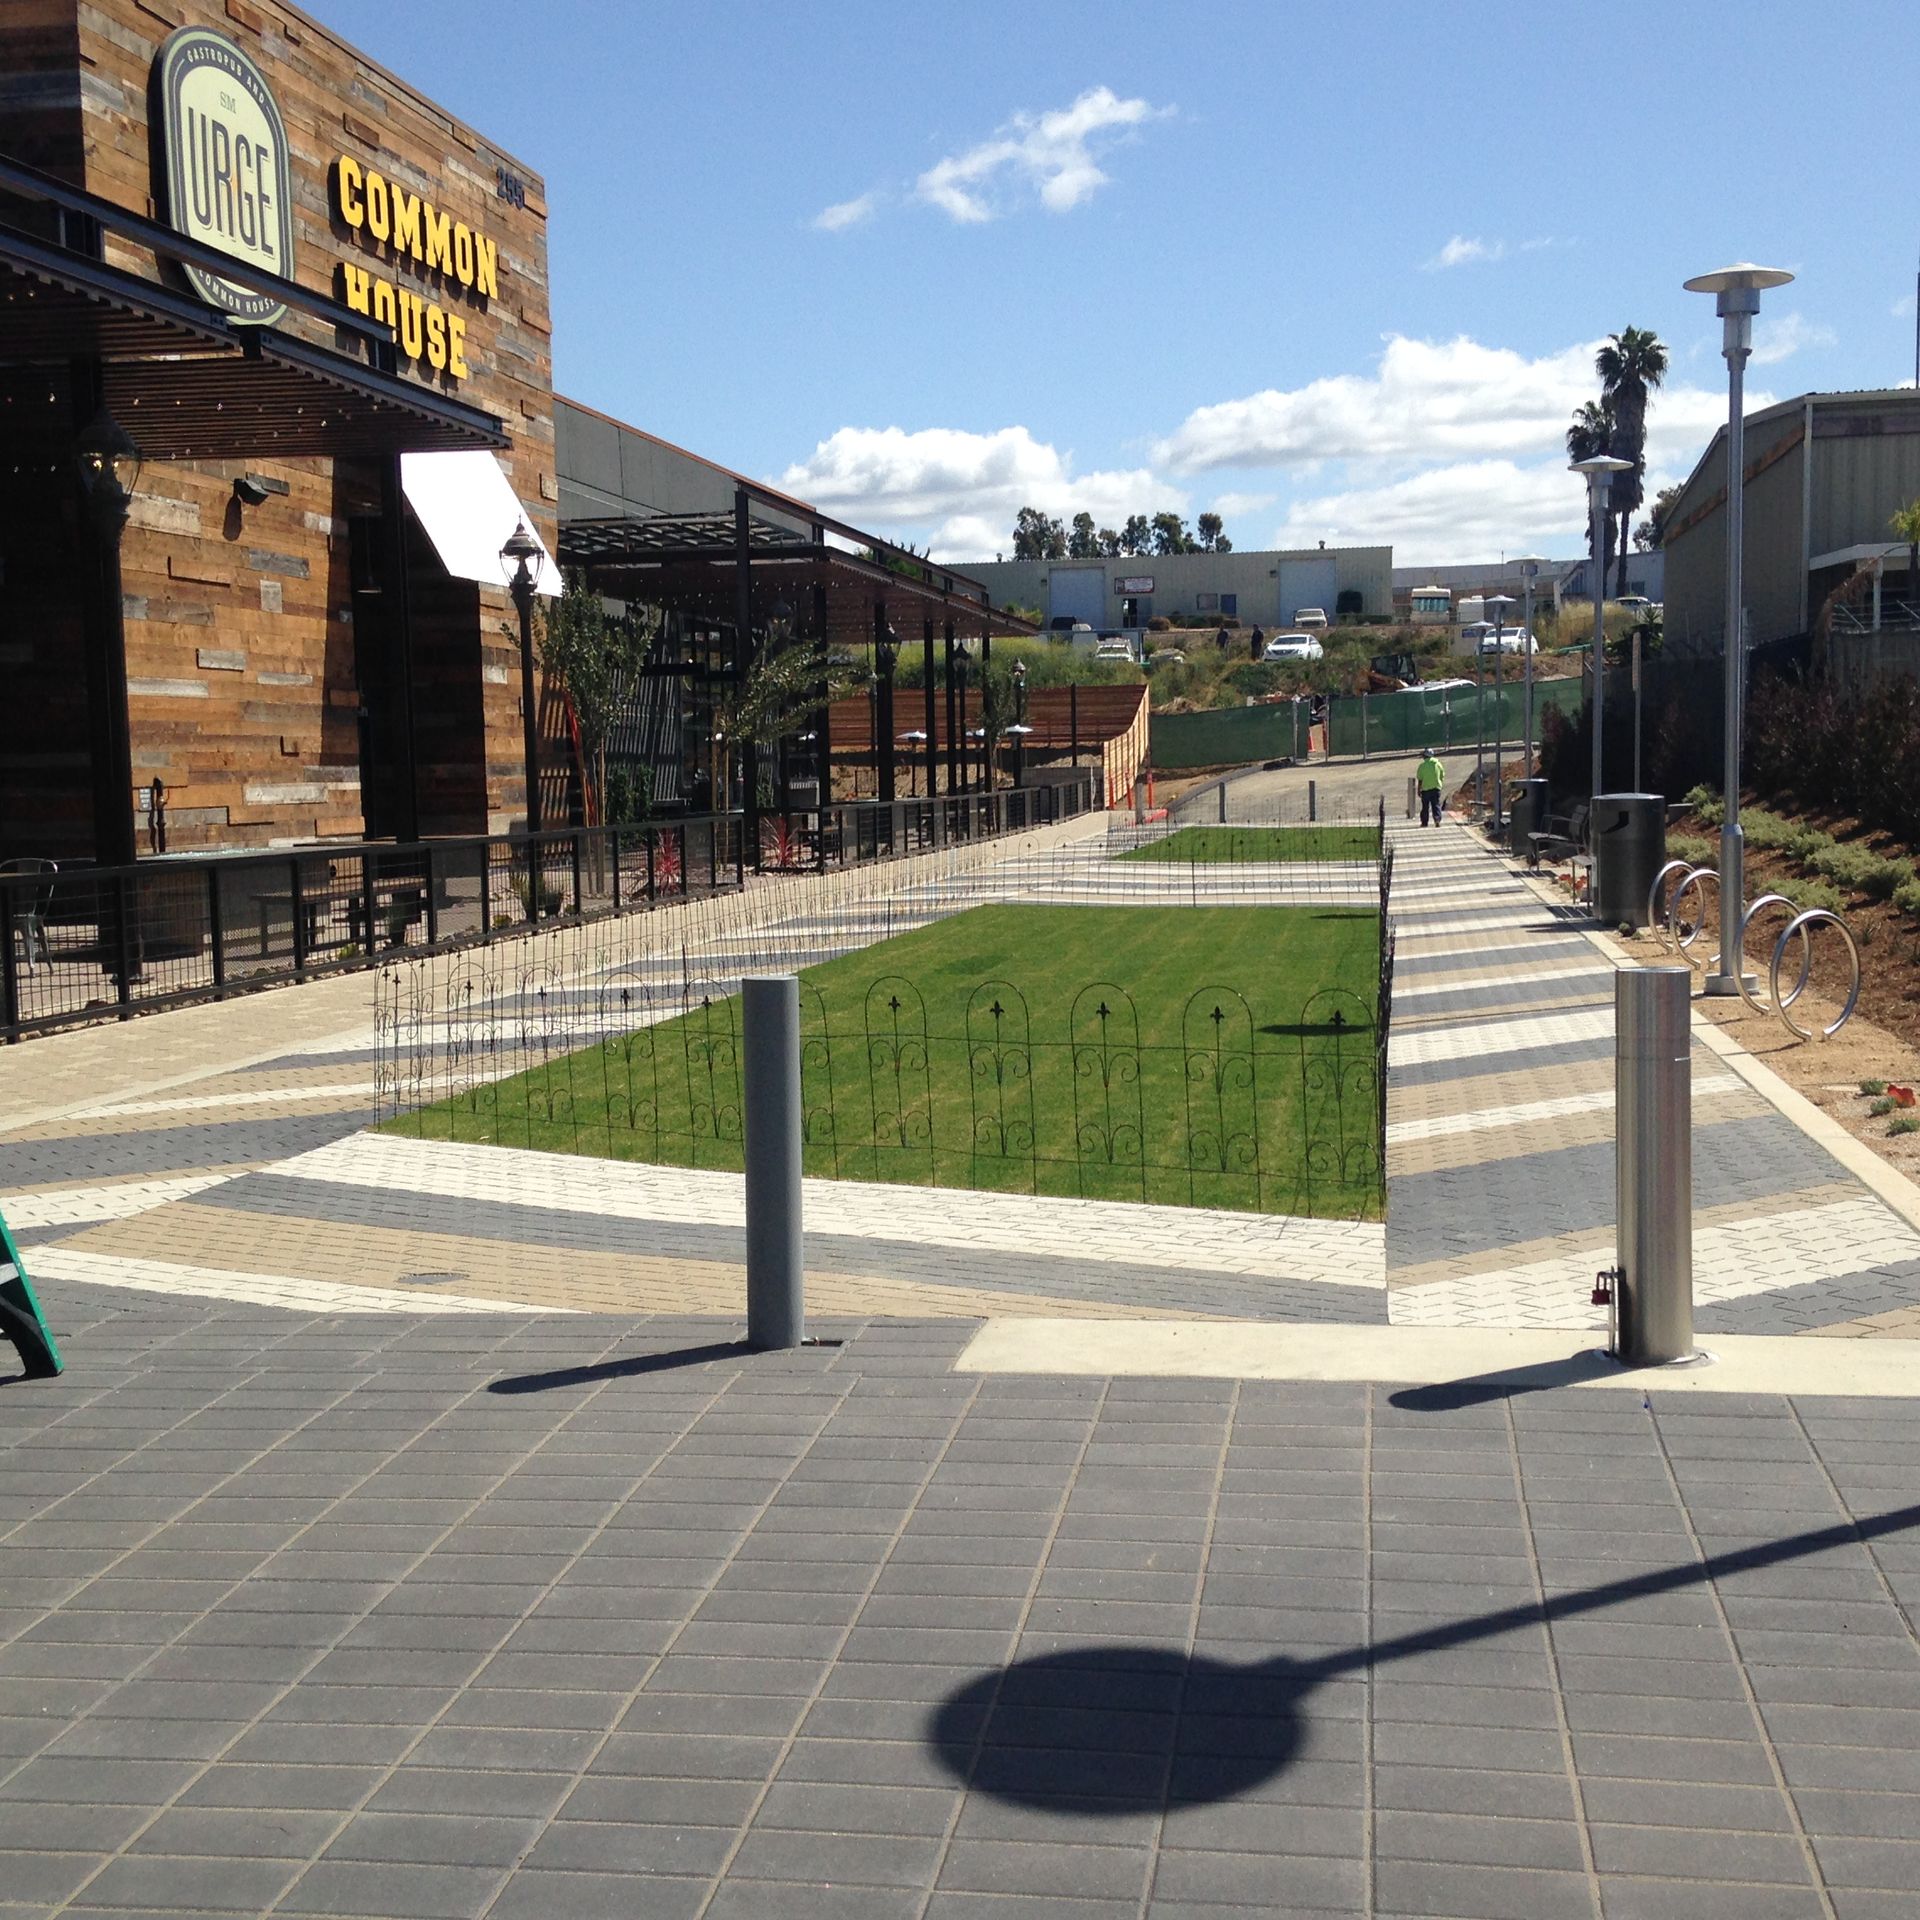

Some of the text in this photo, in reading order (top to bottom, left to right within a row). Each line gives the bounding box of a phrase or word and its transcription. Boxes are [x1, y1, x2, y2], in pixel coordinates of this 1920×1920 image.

[187, 46, 264, 104] GASTROPUB AND
[188, 106, 275, 257] URGE
[338, 154, 498, 300] COMMON
[496, 166, 525, 211] 255
[343, 262, 467, 380] HOUSE
